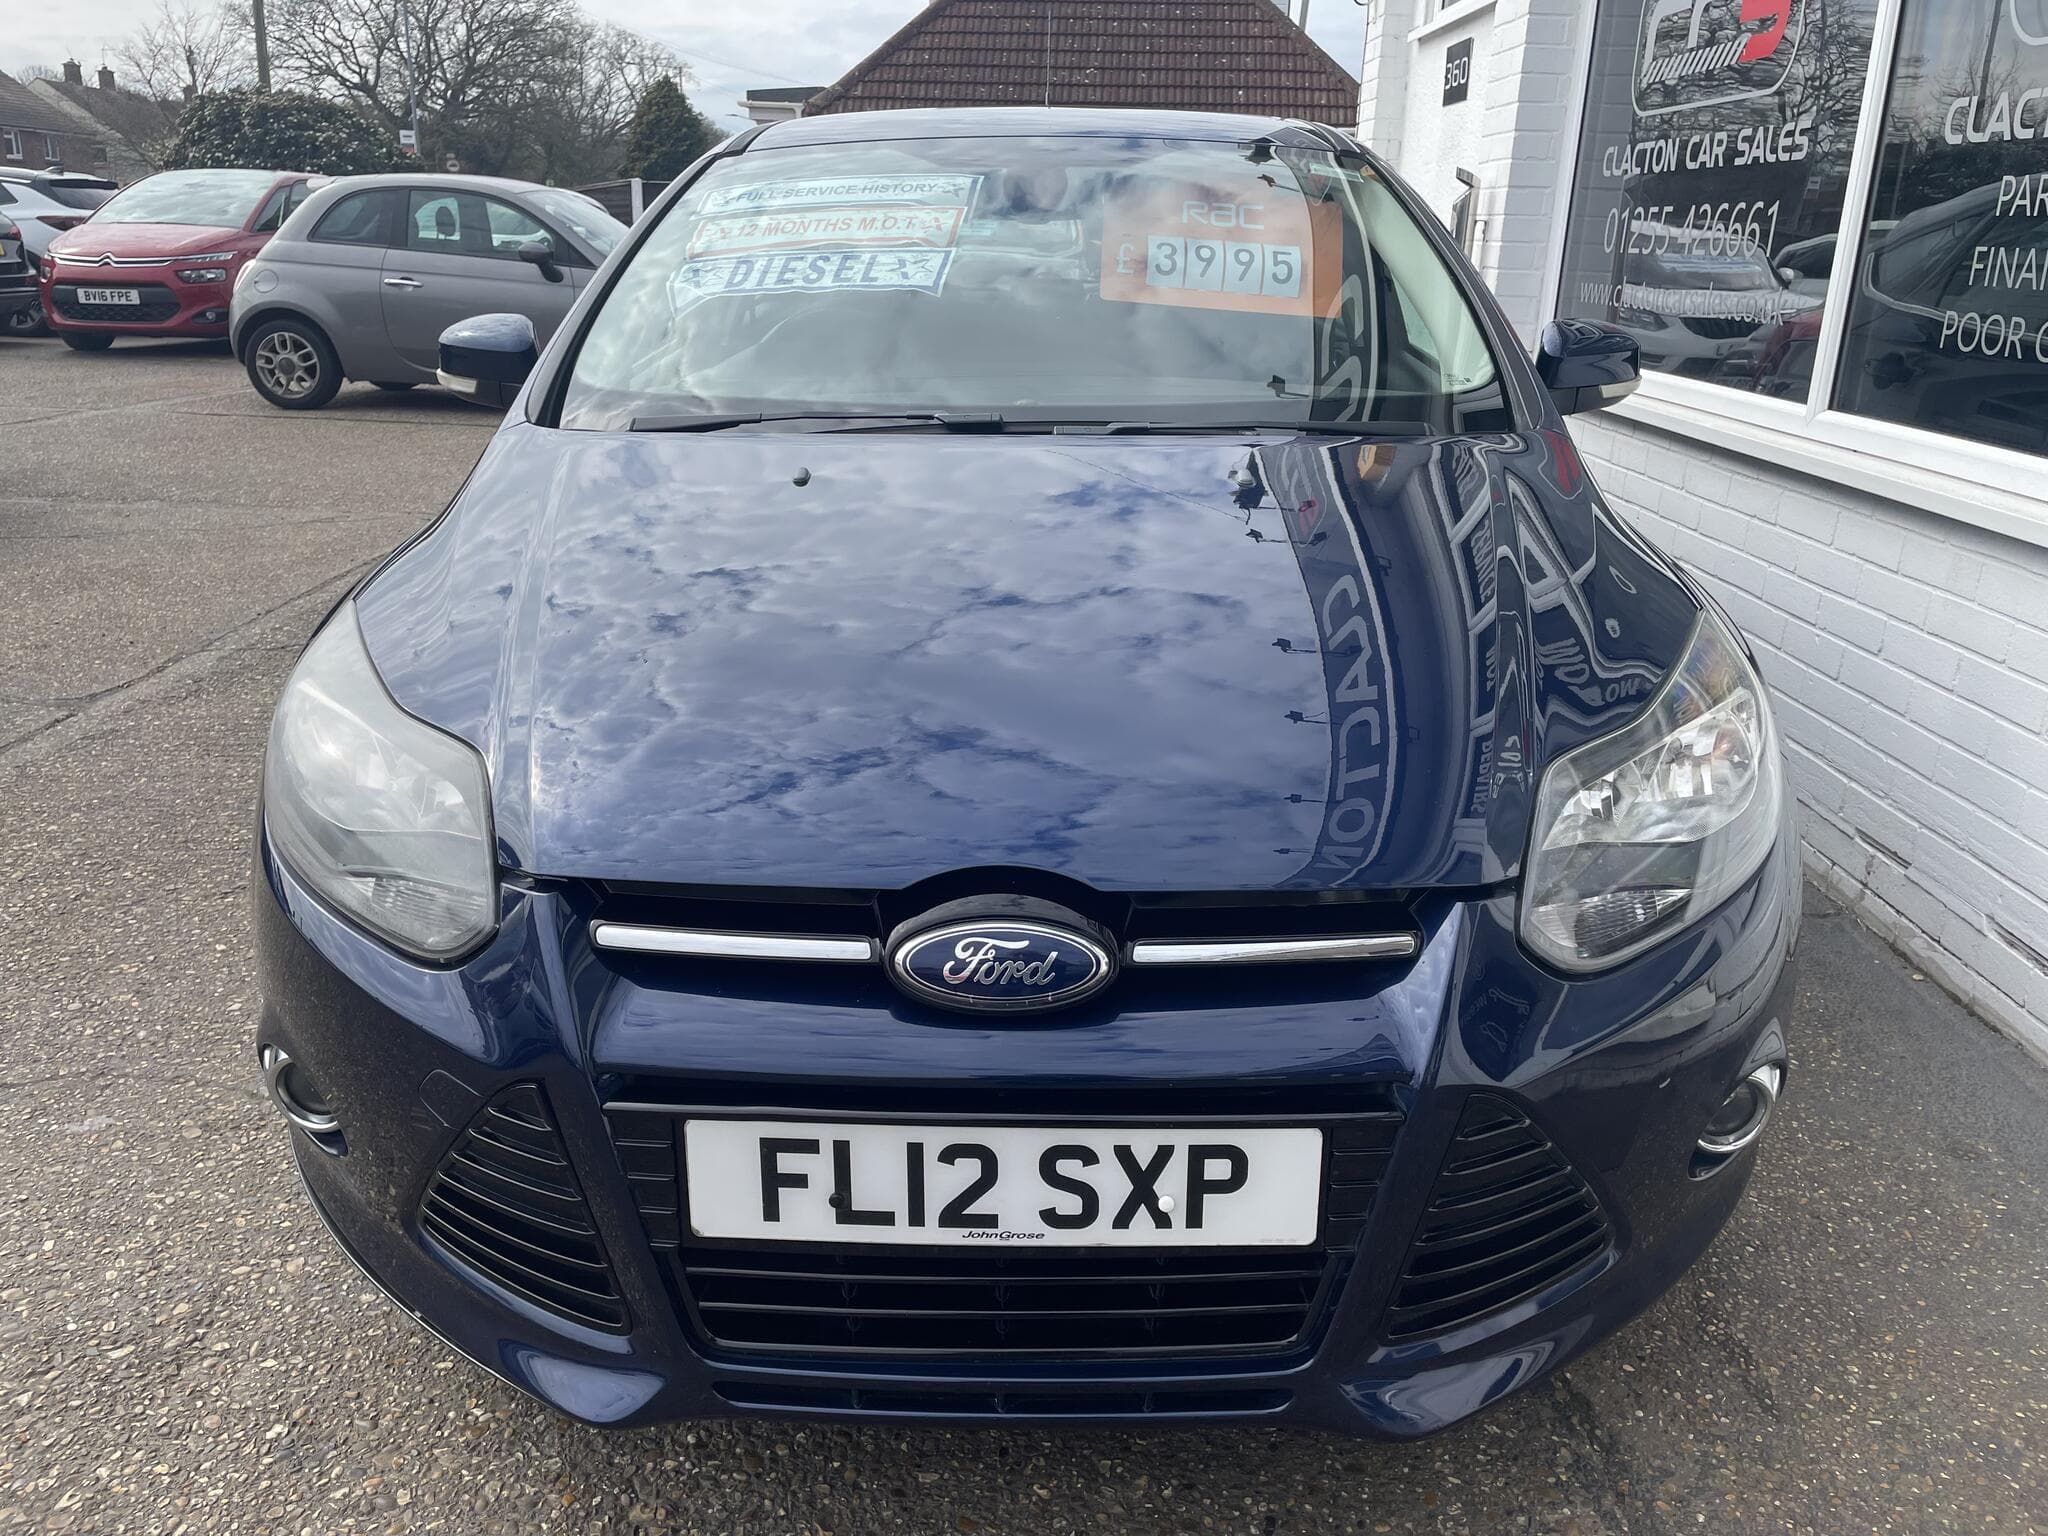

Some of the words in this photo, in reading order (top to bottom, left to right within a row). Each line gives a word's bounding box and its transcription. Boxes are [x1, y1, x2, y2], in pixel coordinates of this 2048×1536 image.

[1444, 57, 1468, 90] 360
[1602, 137, 1680, 178] CLACTON
[1685, 131, 1728, 170] CAR
[1733, 120, 1812, 166] SALES
[735, 189, 778, 203] FULL
[782, 184, 859, 199] SERVICE
[861, 182, 939, 196] HISTORY
[736, 222, 758, 237] 12
[761, 217, 852, 237] MONTHS
[1603, 205, 1674, 255] 01255
[1676, 199, 1780, 258] 426661
[724, 254, 881, 288] DIESEL
[83, 289, 108, 303] BV16
[109, 290, 132, 303] FPE
[1939, 310, 2026, 359] POOR
[943, 936, 1059, 986] Ford
[758, 1136, 1000, 1229] FL12
[1036, 1143, 1249, 1230] SXP
